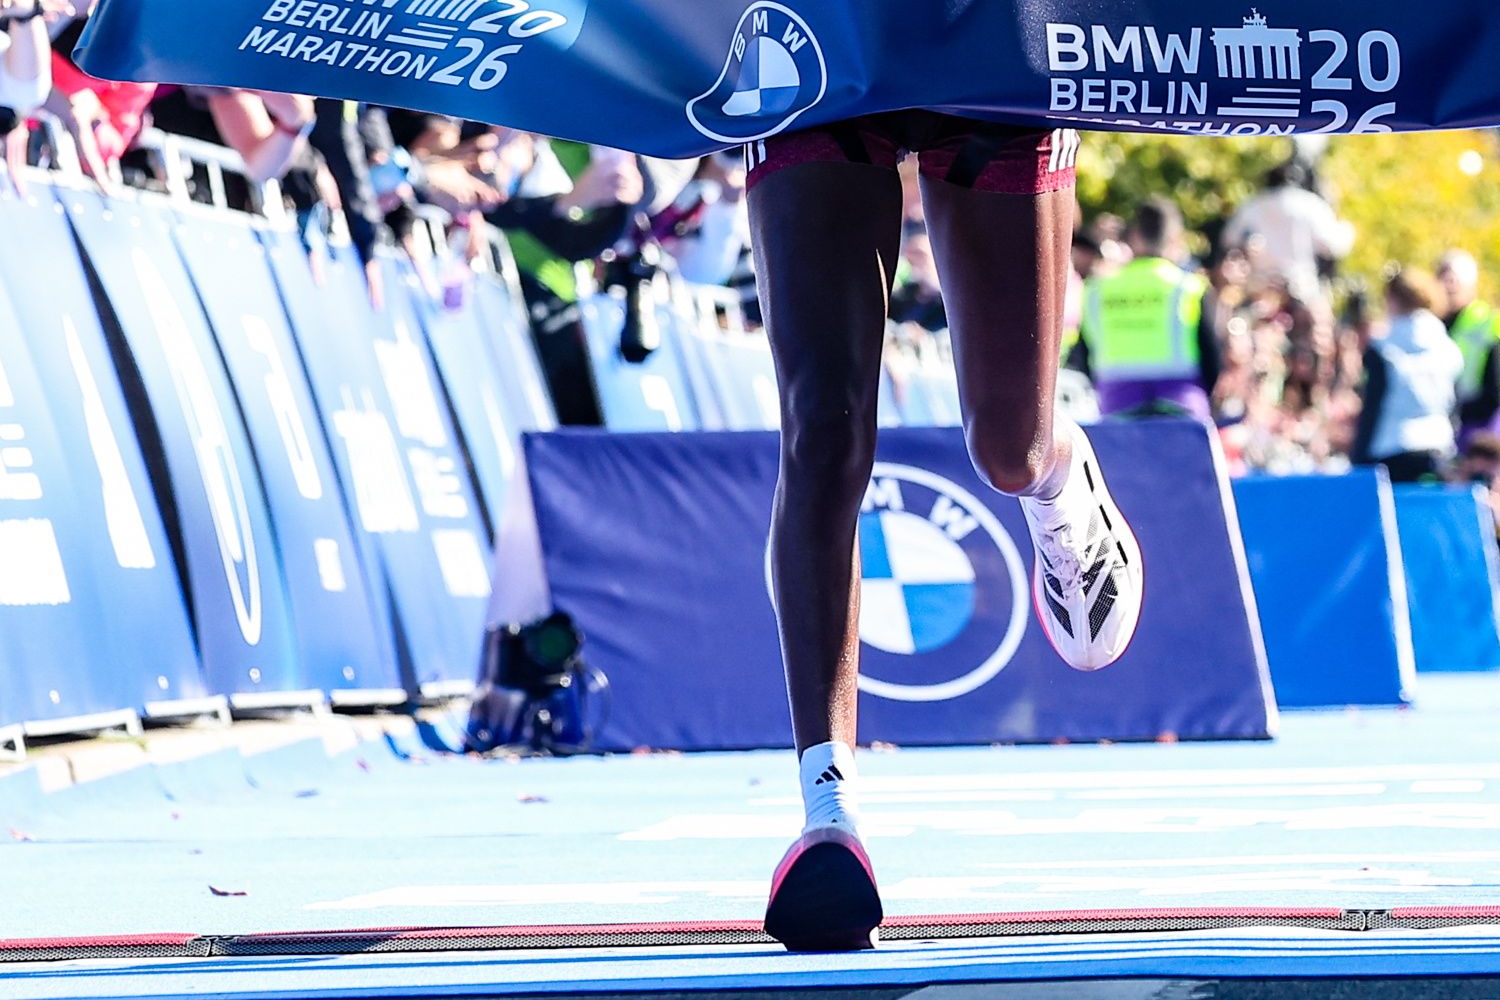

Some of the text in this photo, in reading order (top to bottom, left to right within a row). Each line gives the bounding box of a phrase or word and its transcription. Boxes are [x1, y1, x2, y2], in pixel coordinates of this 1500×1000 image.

[238, 25, 524, 90] MARATHON 26
[734, 10, 808, 63] BMW
[1045, 22, 1401, 93] BMW 20
[1049, 77, 1208, 115] BERLIN
[860, 479, 980, 540] MW
